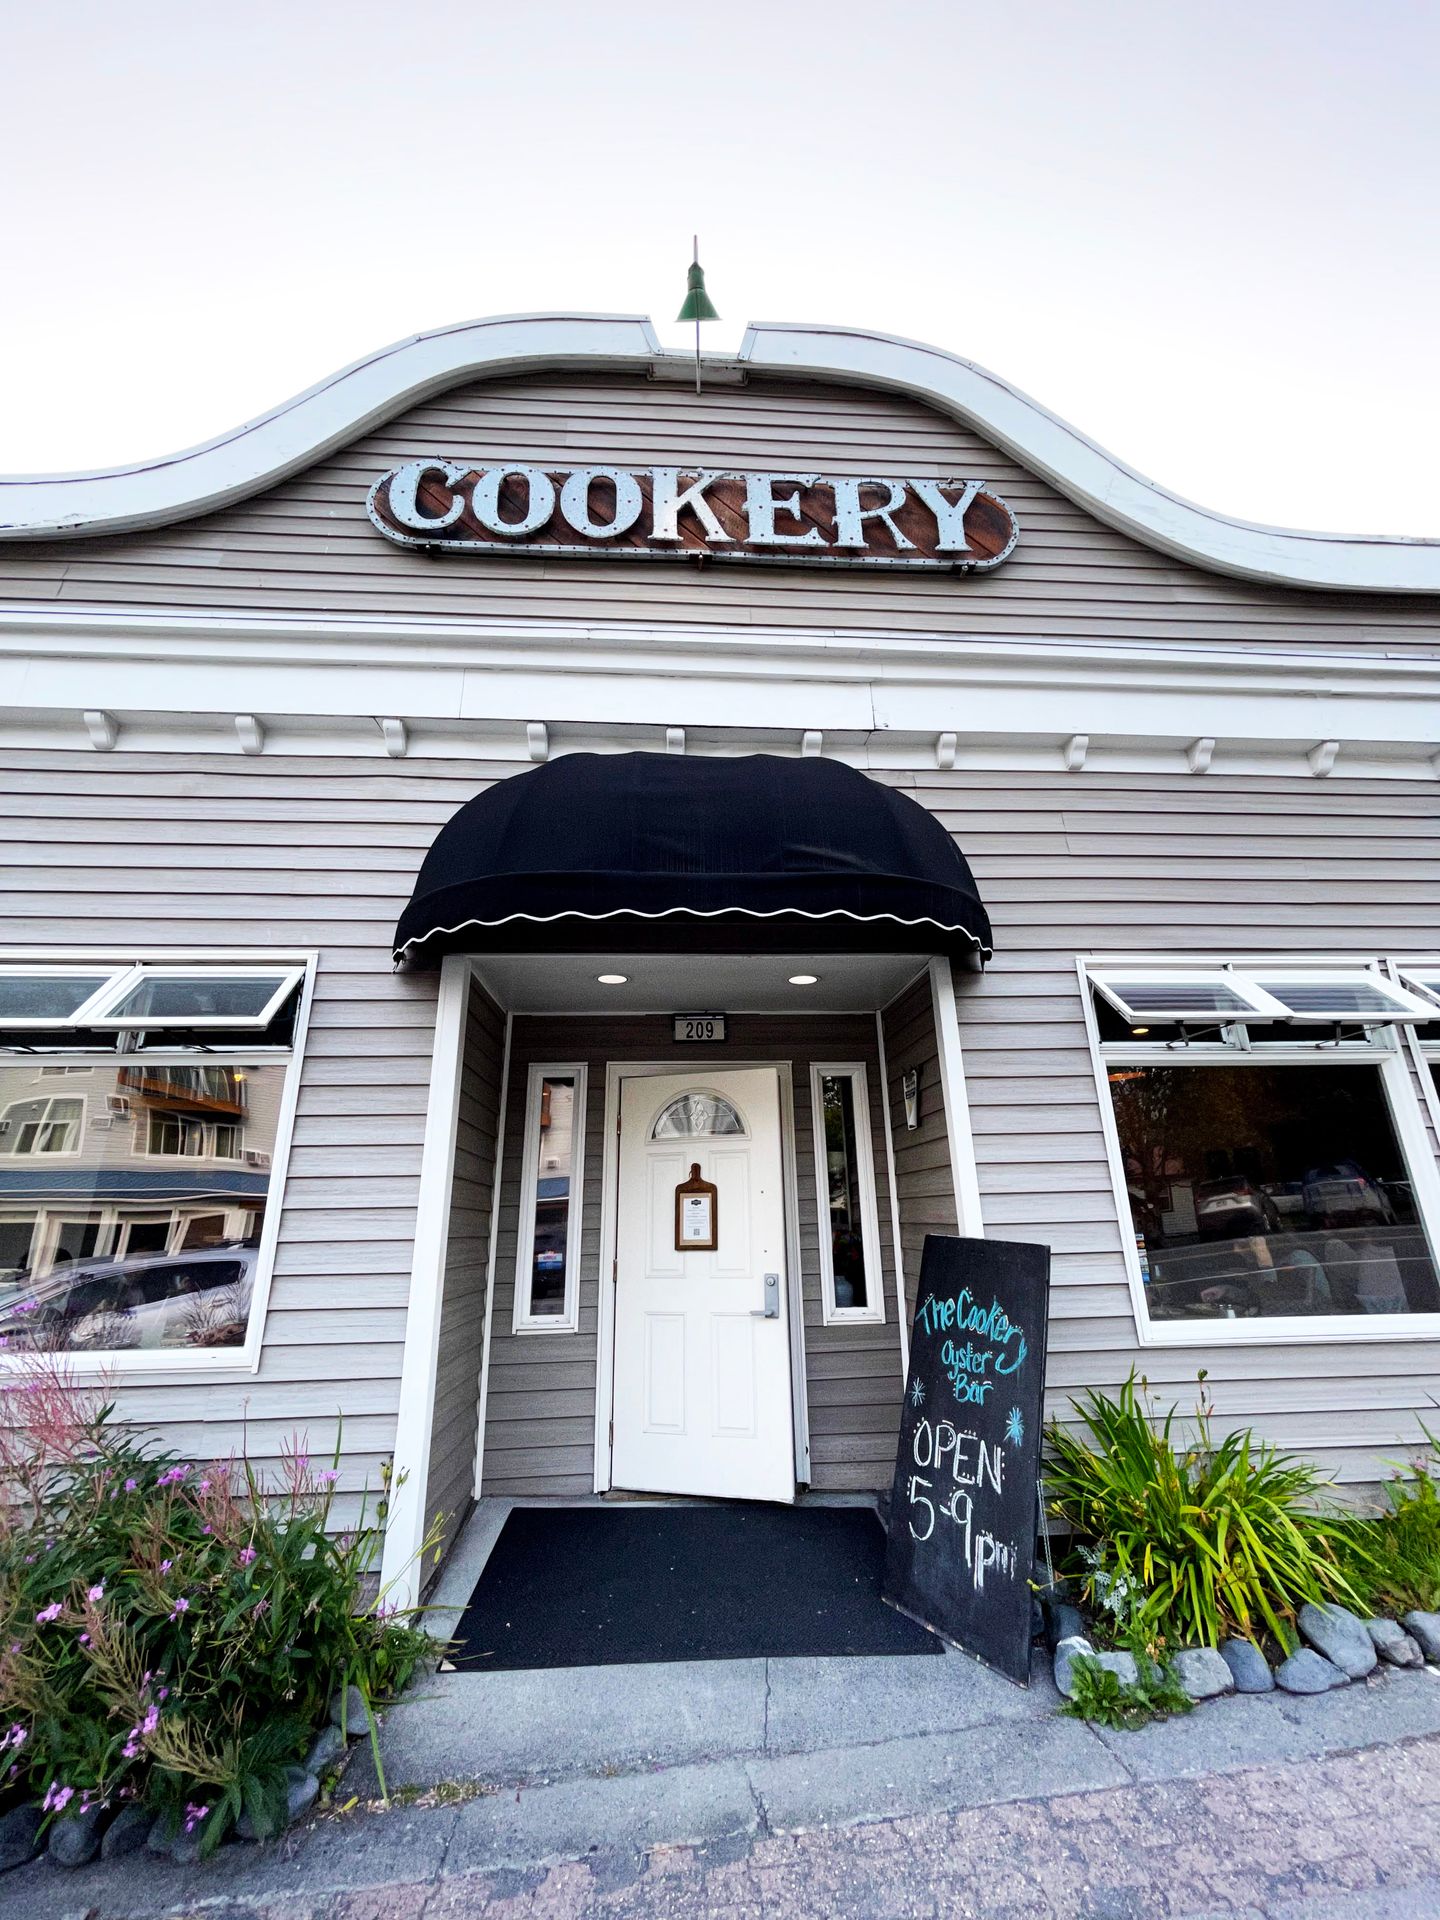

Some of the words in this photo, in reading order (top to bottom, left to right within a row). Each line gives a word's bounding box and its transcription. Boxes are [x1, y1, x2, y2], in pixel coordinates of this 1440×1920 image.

[388, 458, 986, 552] COOKERY
[686, 1021, 714, 1039] 209
[915, 1293, 956, 1336] The
[956, 1287, 1028, 1375] Cookery
[941, 1339, 993, 1381] Oyster
[955, 1373, 994, 1406] Bar
[913, 1419, 1003, 1494] OPEN
[907, 1476, 974, 1568] 5-9
